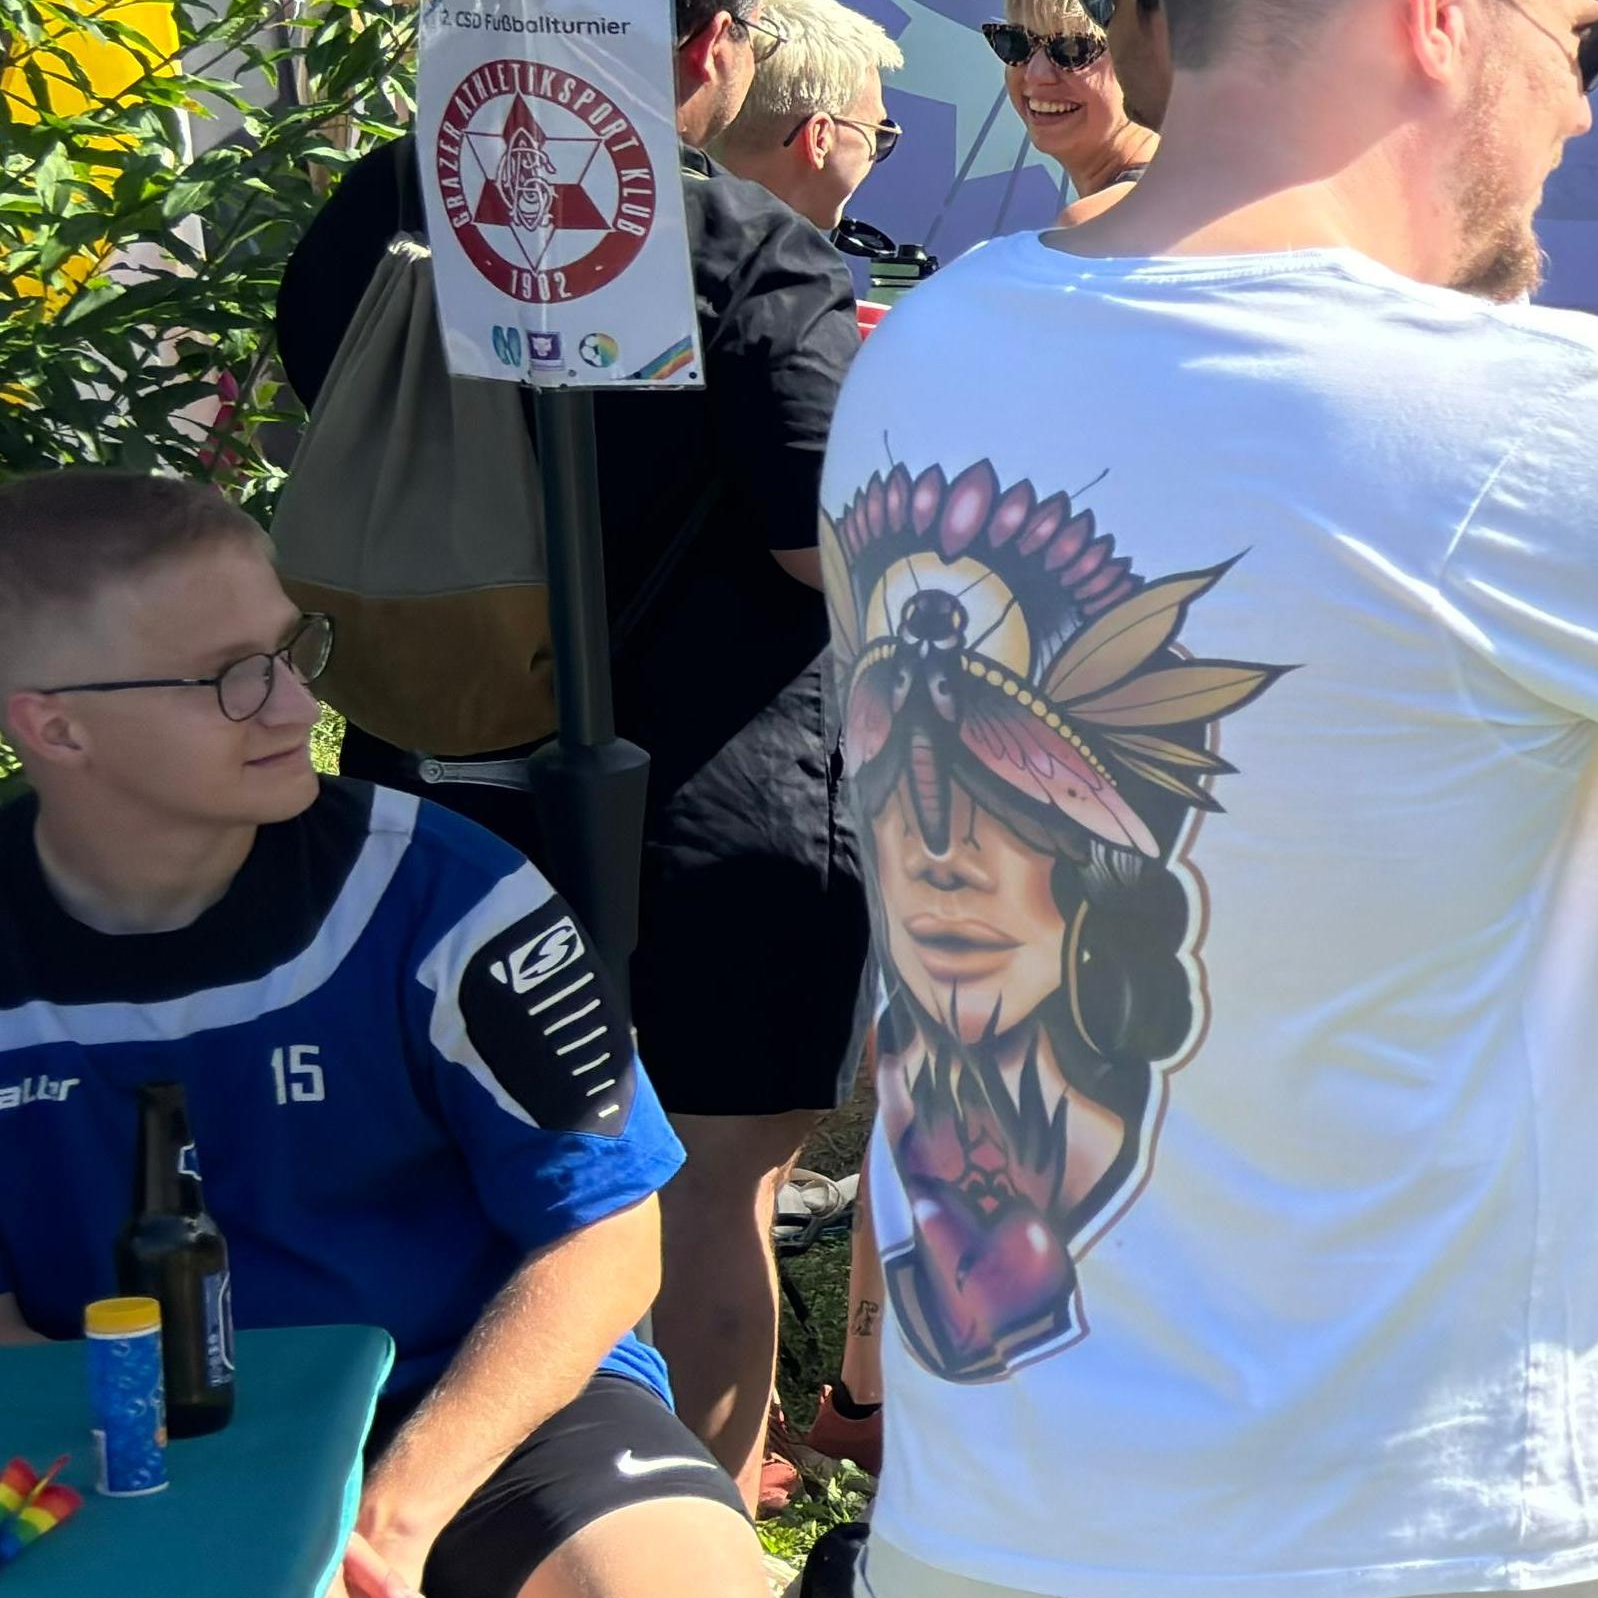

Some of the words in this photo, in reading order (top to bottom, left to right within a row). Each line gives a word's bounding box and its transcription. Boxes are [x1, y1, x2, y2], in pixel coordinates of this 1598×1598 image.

[455, 11, 482, 29] CSD
[485, 13, 632, 35] Fußballturnier
[454, 63, 640, 153] ATHLETIKSPORT
[438, 120, 472, 230] GRAZER
[614, 167, 653, 237] KLUB
[509, 268, 573, 301] 1902
[270, 1045, 326, 1105] 15
